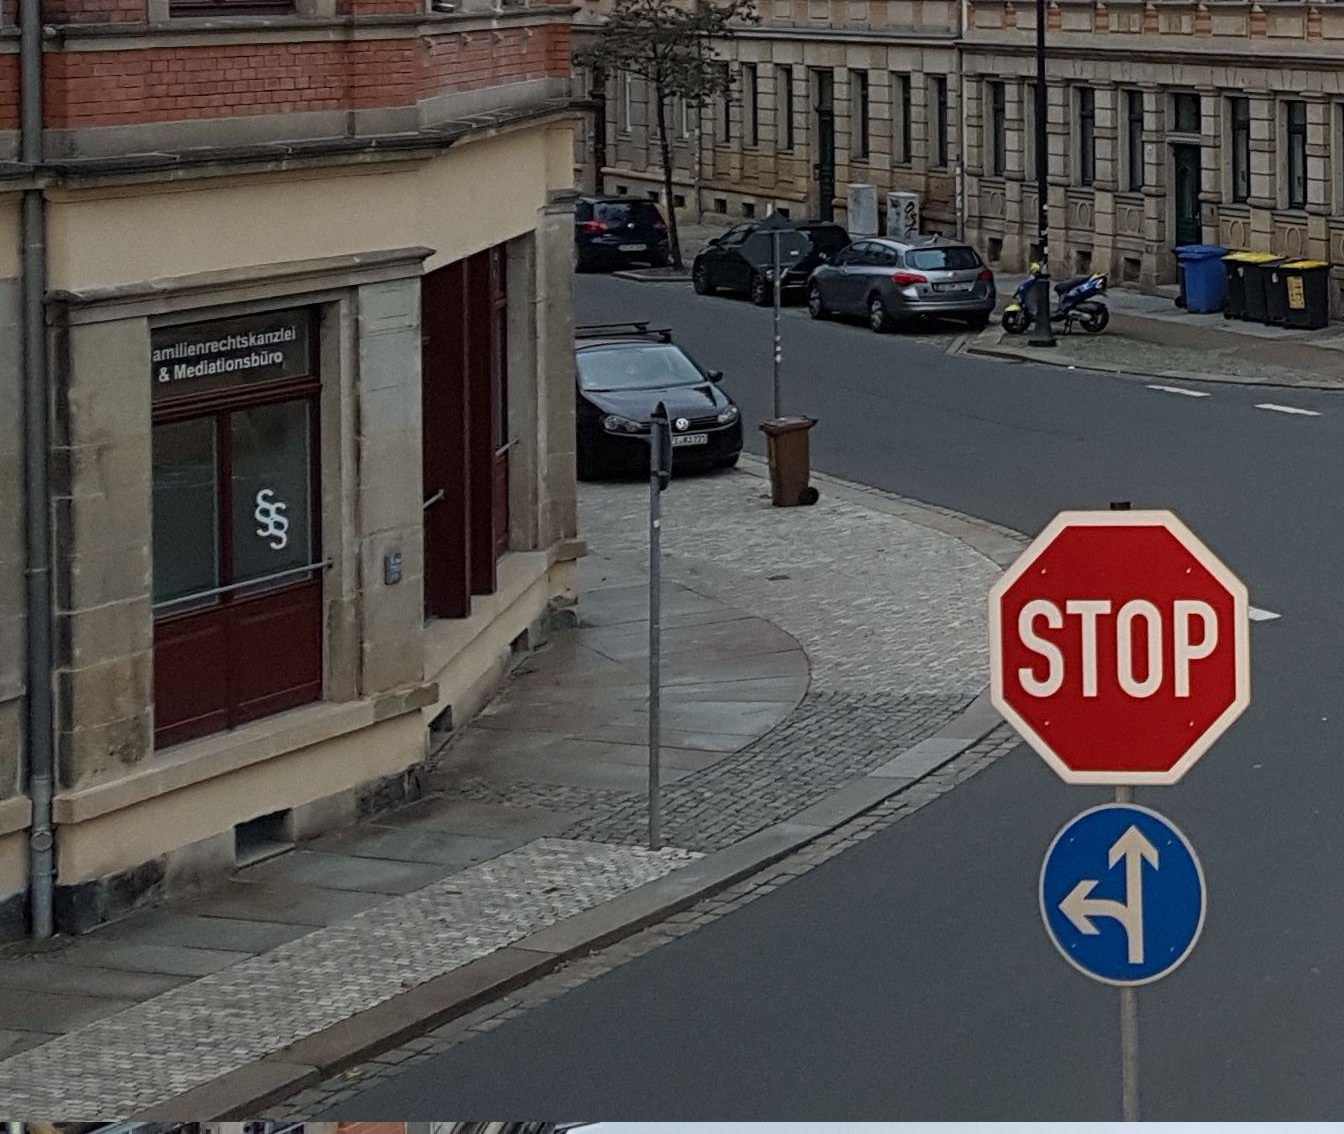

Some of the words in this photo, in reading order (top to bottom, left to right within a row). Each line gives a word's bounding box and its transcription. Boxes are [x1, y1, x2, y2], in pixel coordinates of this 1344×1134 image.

[152, 325, 297, 362] amilienrechtskanzlei
[158, 366, 171, 383] &
[174, 351, 284, 381] Mediationsbüro
[1017, 598, 1219, 699] STOP
